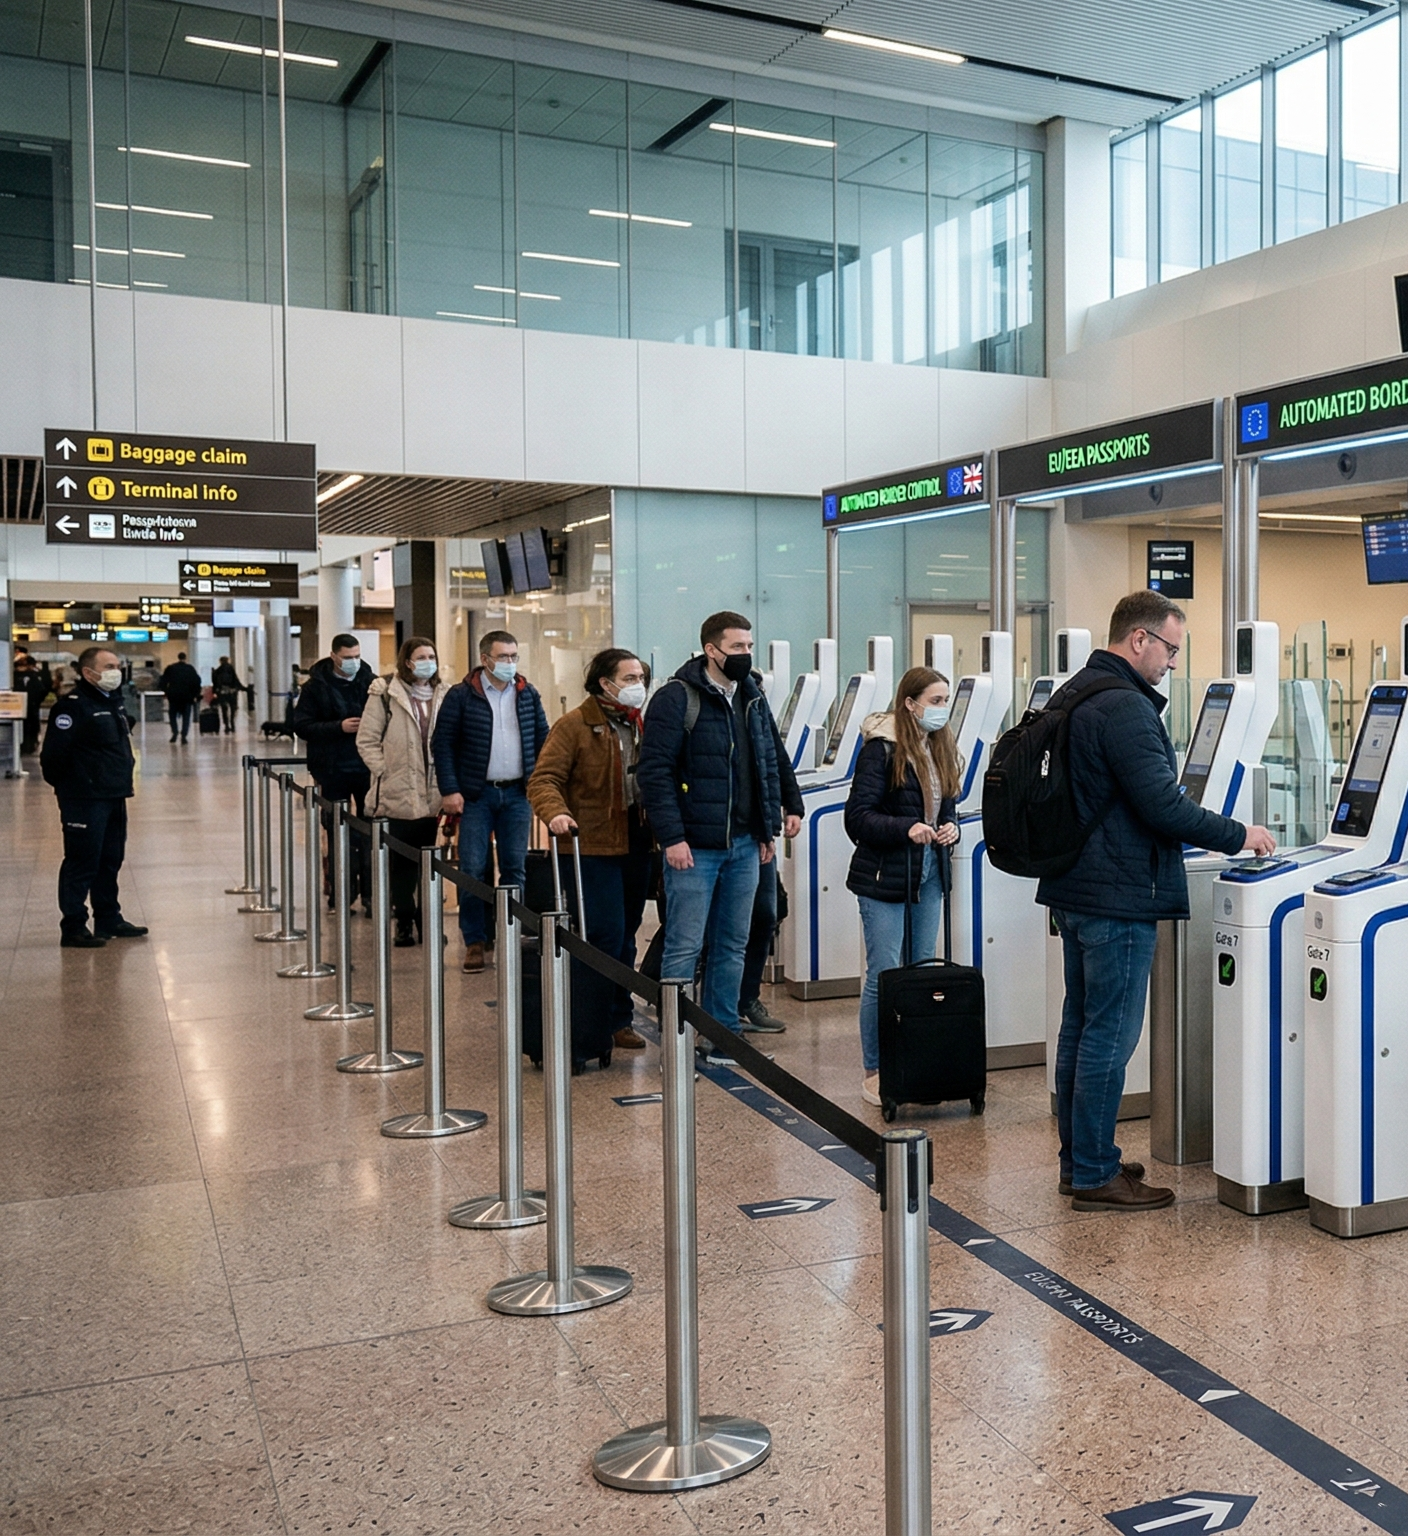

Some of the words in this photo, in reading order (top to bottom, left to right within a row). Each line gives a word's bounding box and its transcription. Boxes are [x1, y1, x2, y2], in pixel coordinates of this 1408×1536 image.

[1279, 389, 1366, 428] AUTOMATED
[120, 442, 197, 466] Baggage
[201, 446, 248, 465] claim
[1086, 433, 1150, 466] PASSPORTS
[120, 480, 198, 500] Terminal
[202, 484, 238, 502] info
[1324, 948, 1330, 961] 7
